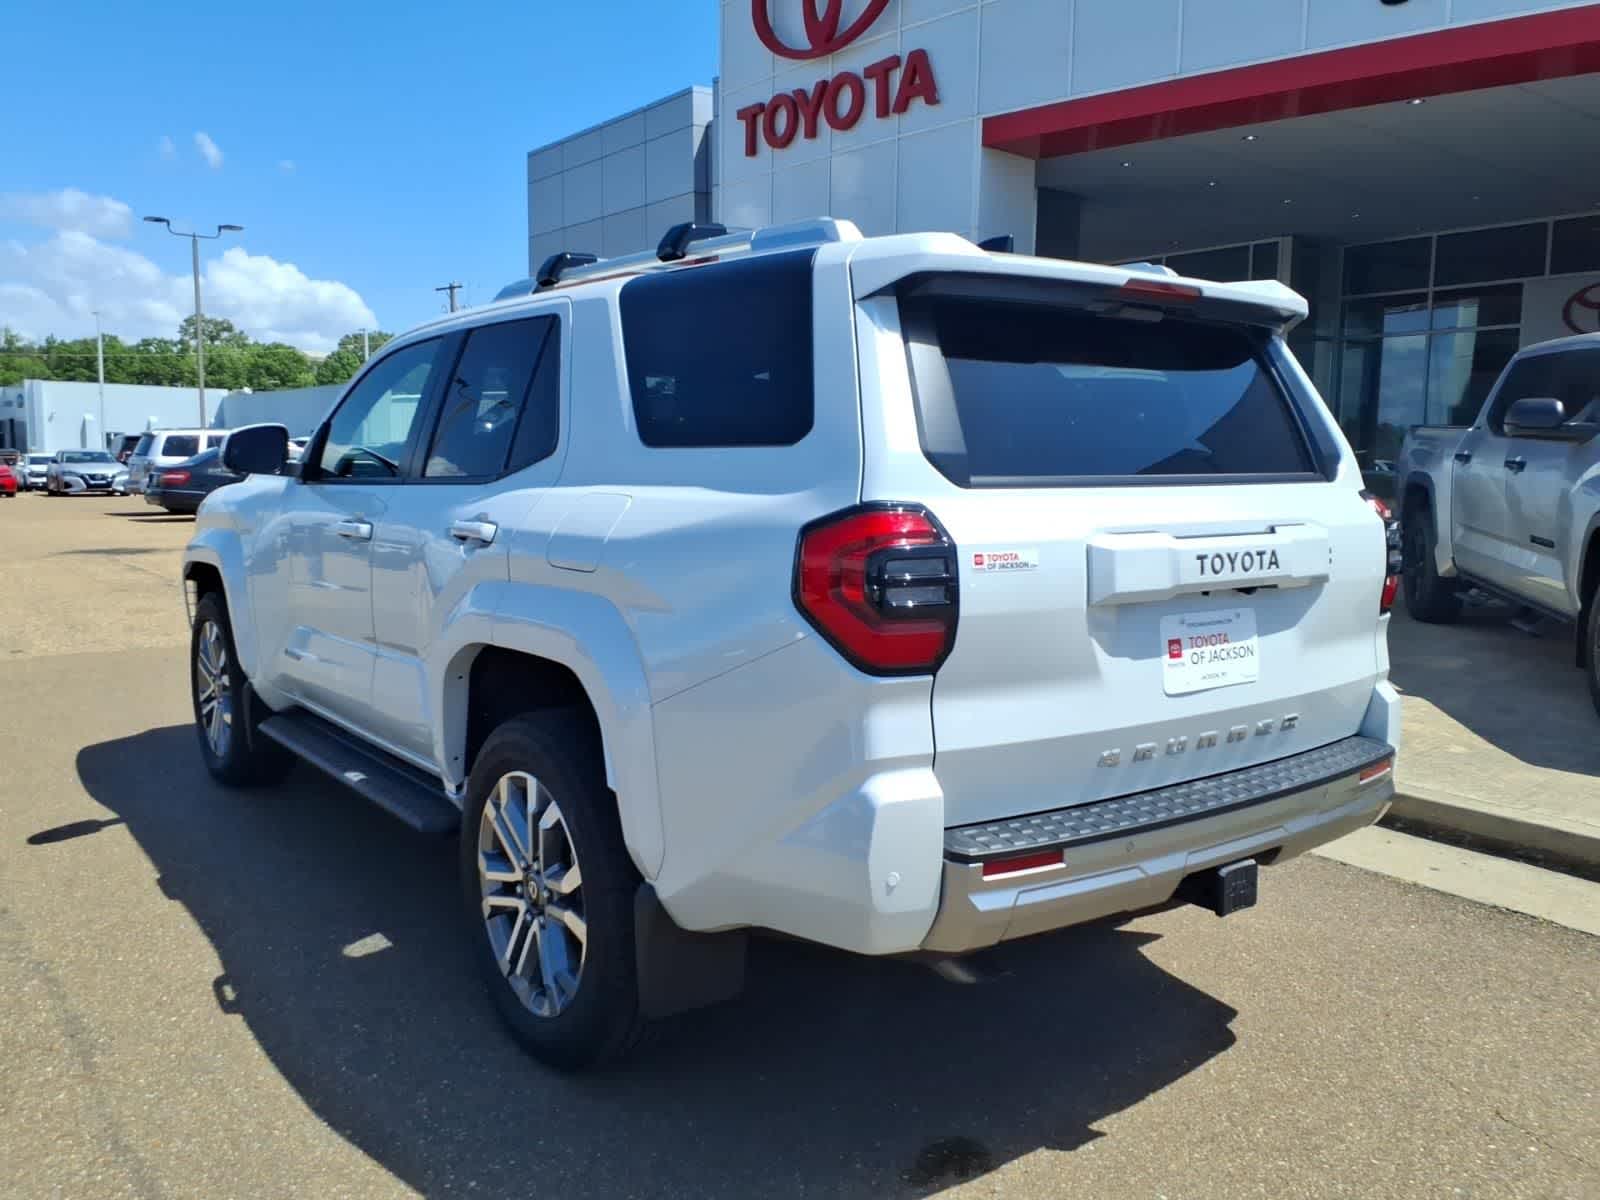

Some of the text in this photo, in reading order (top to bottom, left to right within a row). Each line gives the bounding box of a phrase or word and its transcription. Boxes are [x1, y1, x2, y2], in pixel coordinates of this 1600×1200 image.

[737, 48, 940, 157] TOYOTA
[987, 553, 1019, 562] TOYOTA
[1196, 549, 1280, 576] TOYOTA
[1188, 632, 1230, 649] TOYOTA
[1190, 645, 1255, 665] OF JACKSON
